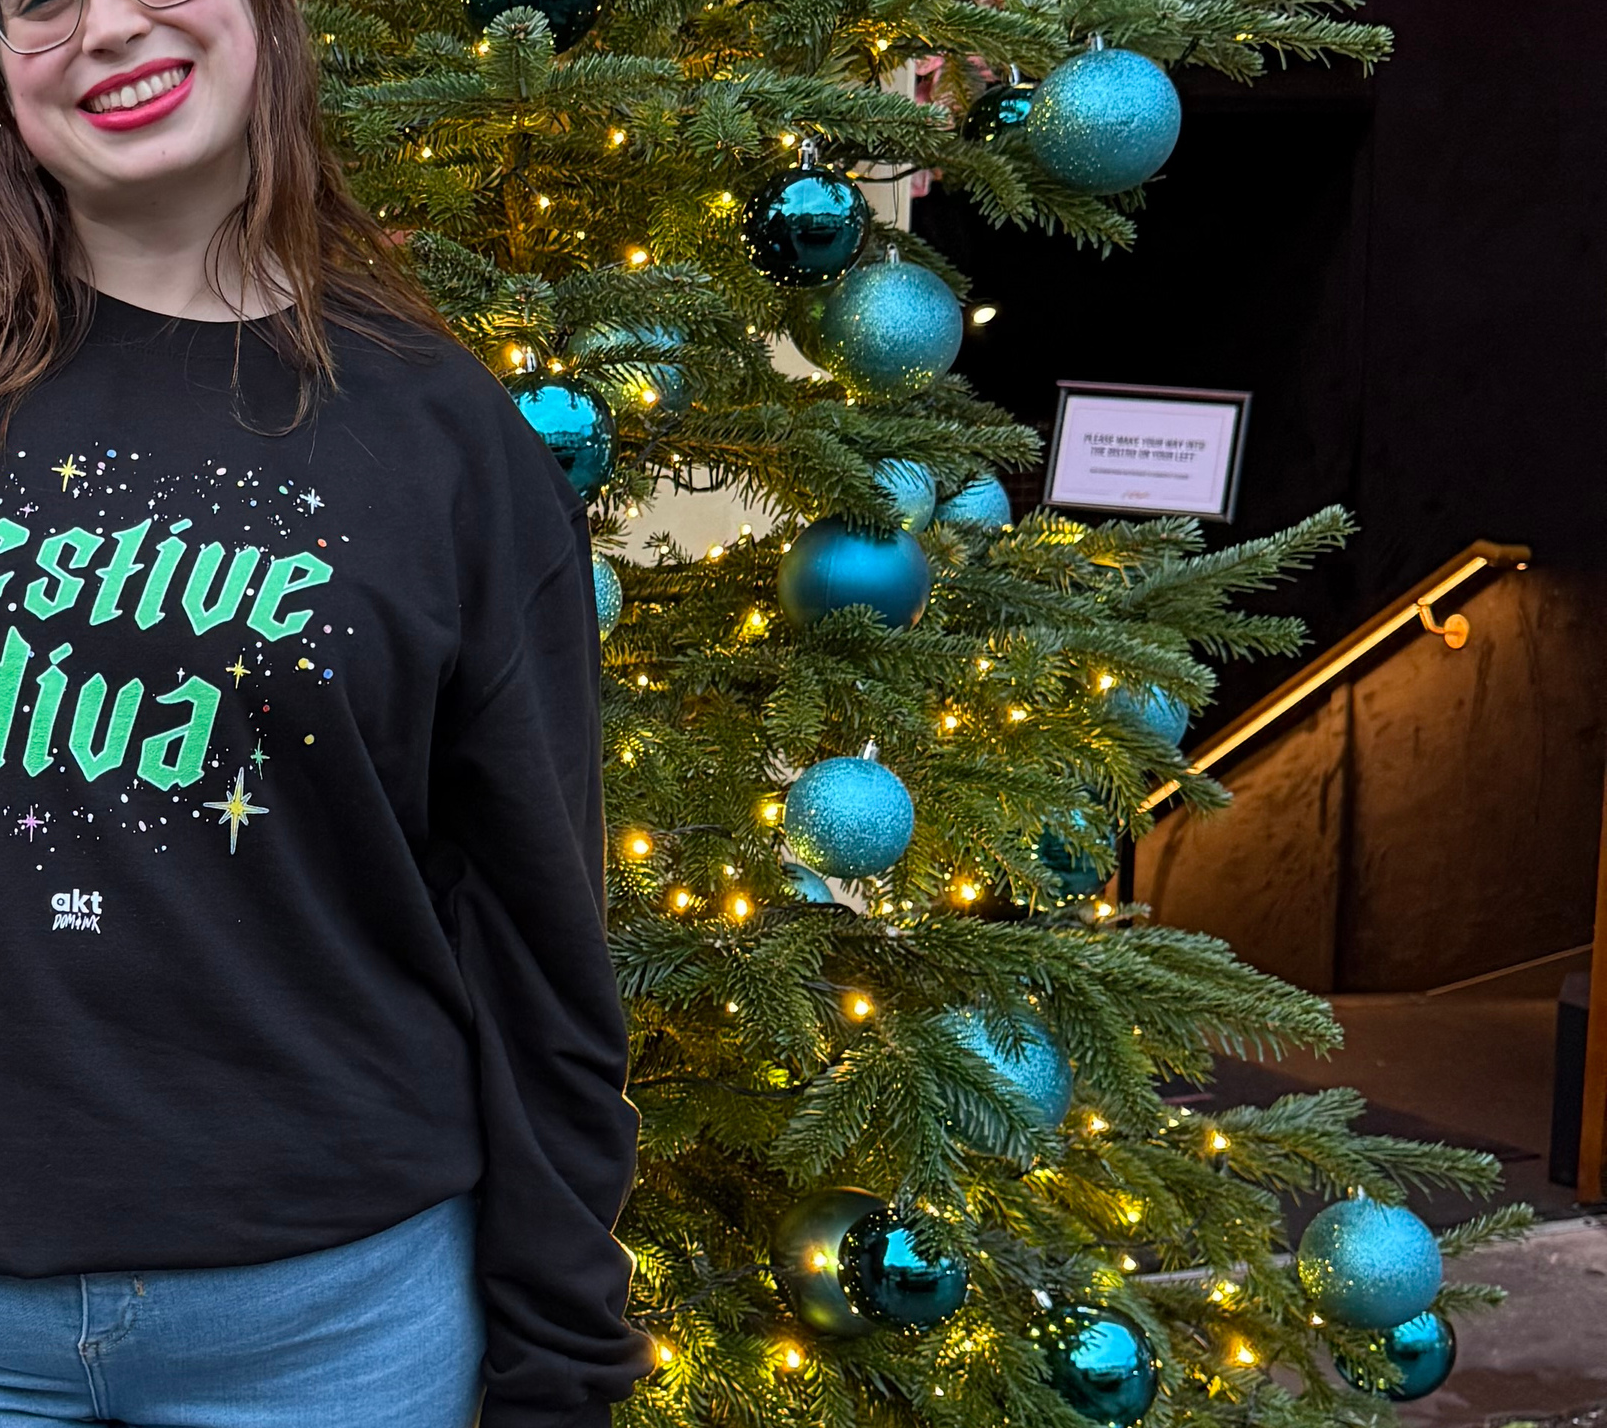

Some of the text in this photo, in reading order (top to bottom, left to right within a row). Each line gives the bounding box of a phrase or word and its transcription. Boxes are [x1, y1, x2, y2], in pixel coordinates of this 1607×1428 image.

[1084, 433, 1206, 451] PLEASE MAKE YOUR WAY INTO
[1091, 446, 1106, 457] THE
[1152, 450, 1174, 461] YOUR
[1175, 452, 1196, 463] LEFT
[51, 888, 103, 915] akt
